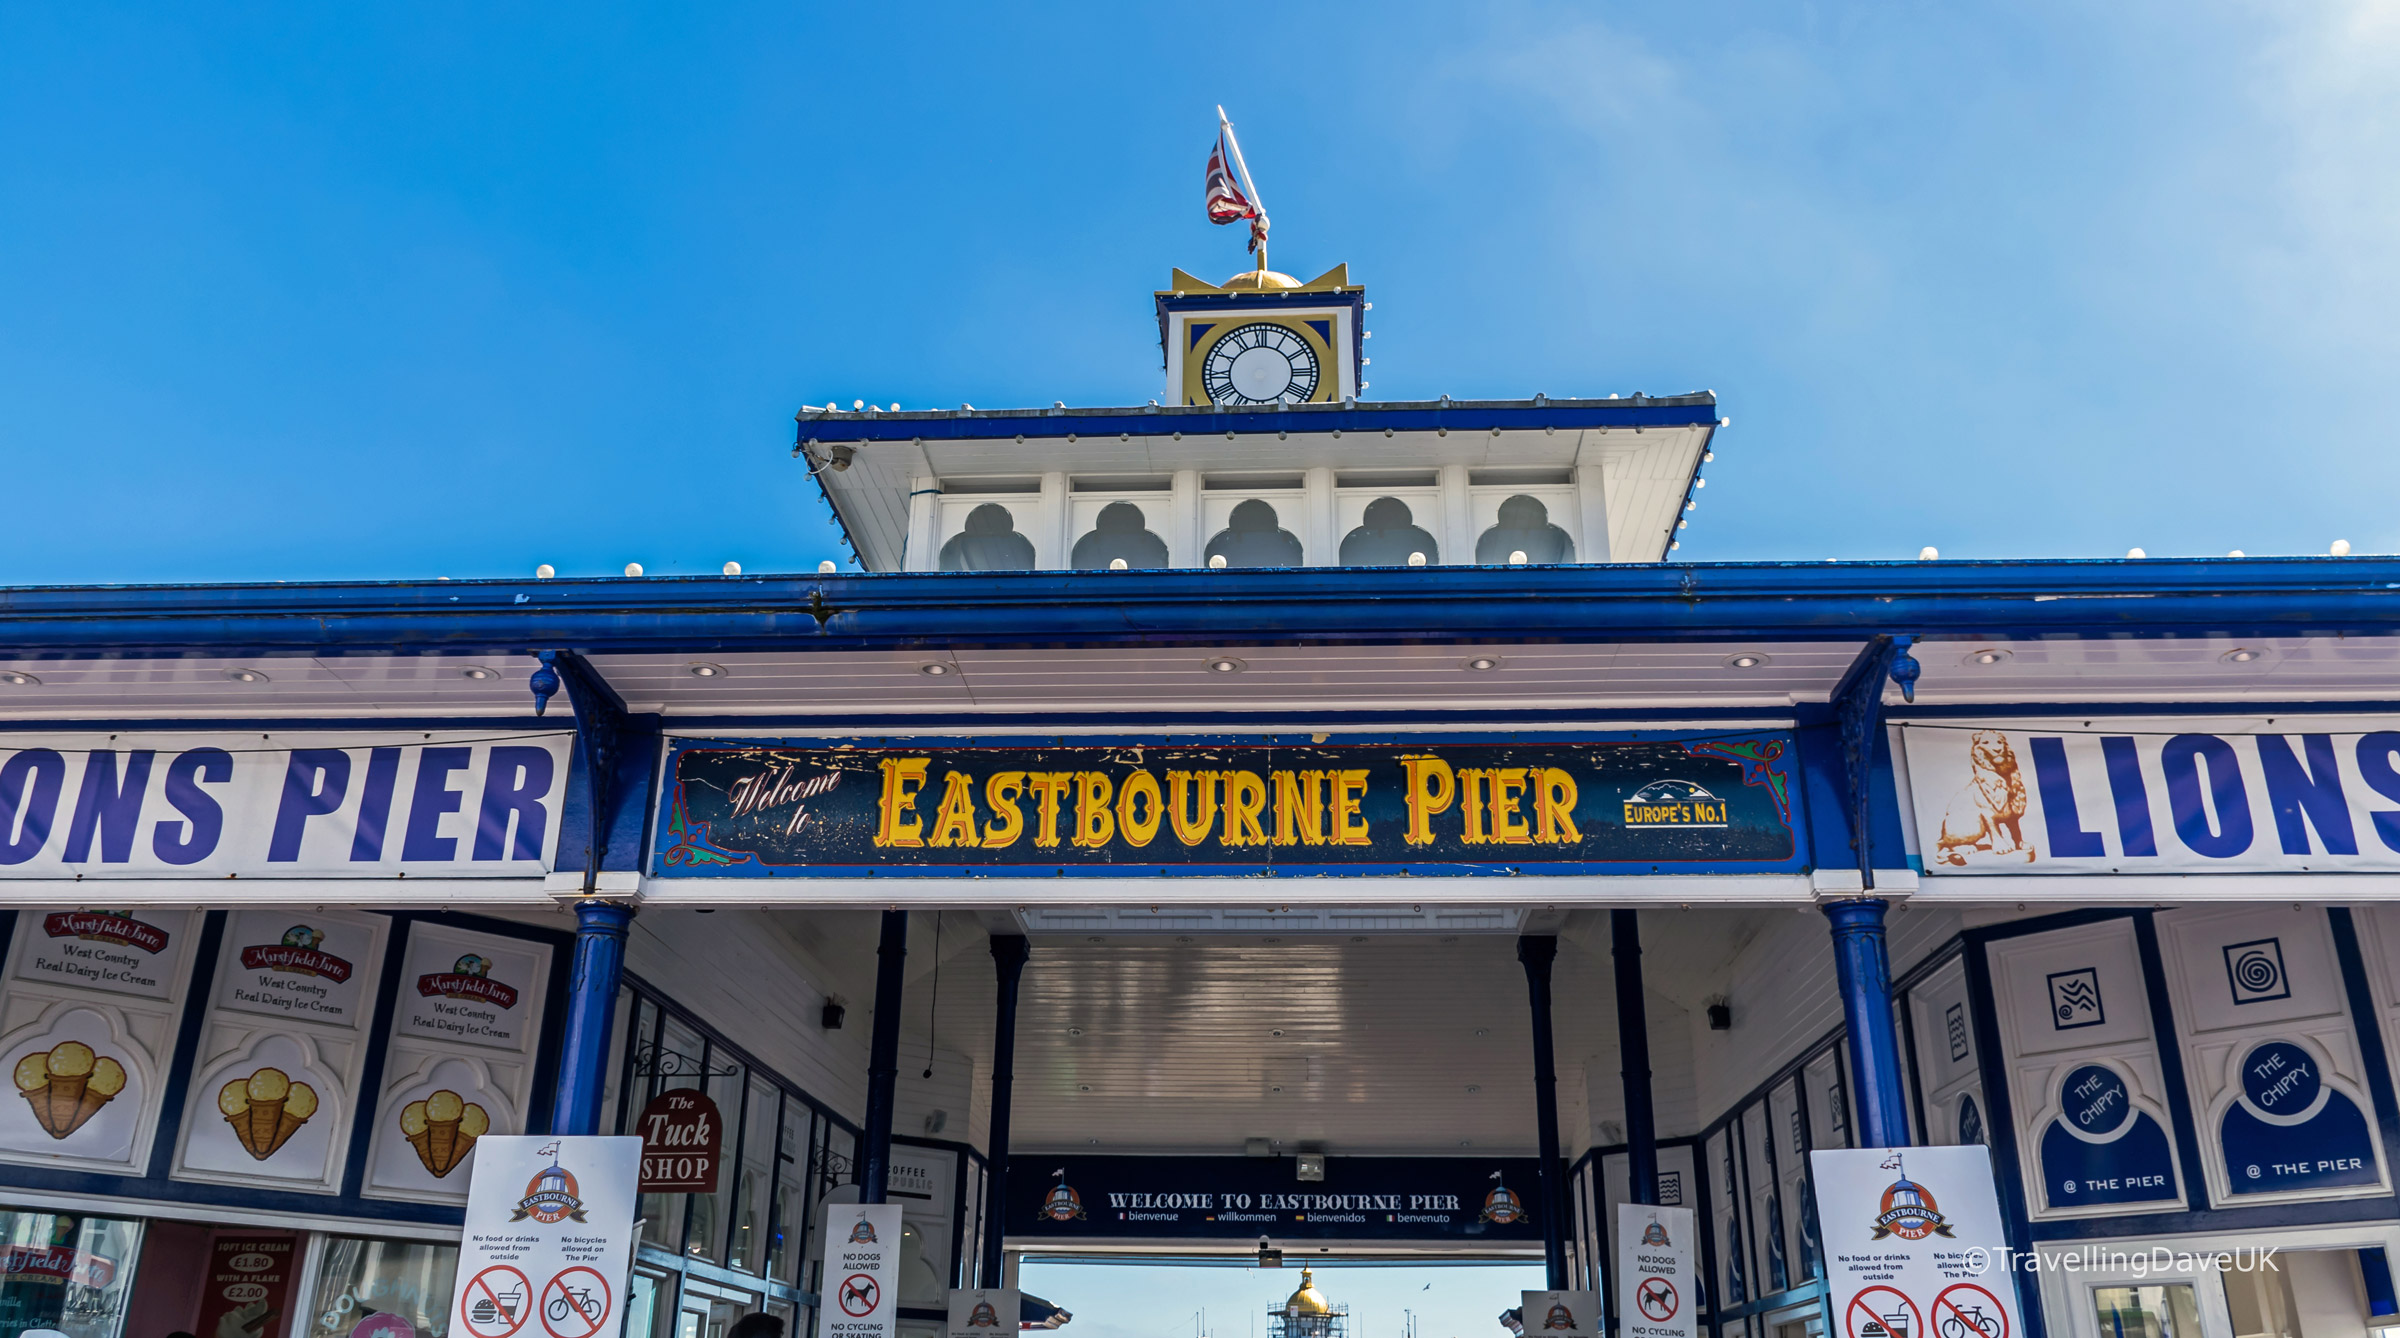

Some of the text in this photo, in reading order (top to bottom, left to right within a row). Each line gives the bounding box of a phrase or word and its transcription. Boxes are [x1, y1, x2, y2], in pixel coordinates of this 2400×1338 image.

[728, 764, 842, 819] Welcome
[873, 754, 1583, 848] EASTBOURNE PIER
[266, 746, 554, 862] PIER
[787, 804, 810, 836] to
[51, 914, 128, 935] Marshfield
[128, 923, 160, 947] Farm
[63, 944, 140, 969] West Country
[249, 947, 316, 967] Marshfield
[316, 954, 344, 978] Farm
[36, 958, 156, 986] Real Dairy Ice Cream
[259, 976, 327, 998] West Country
[425, 975, 484, 993] Marshfield
[484, 982, 510, 1004] Farm
[235, 988, 342, 1014] Real Dairy Ice Cream
[434, 1003, 495, 1023] West Country
[413, 1015, 510, 1038] Real Dairy Ice Cream
[2253, 1053, 2286, 1080] THE
[2074, 1075, 2103, 1100] THE
[2260, 1063, 2310, 1107] CHIPPY
[668, 1096, 695, 1110] The
[2079, 1084, 2124, 1126] CHIPPY
[647, 1112, 711, 1146] Tuck
[642, 1158, 709, 1180] SHOP
[2272, 1161, 2310, 1175] THE
[2318, 1158, 2362, 1172] PIER
[888, 1176, 933, 1190] PUBLIC
[2086, 1178, 2121, 1190] THE
[2126, 1175, 2165, 1188] PIER
[523, 1192, 579, 1209] EASTBOURNE
[1108, 1193, 1460, 1210] WELCOME TO EASTBOURNE PIER
[536, 1211, 560, 1222] PIER
[1129, 1211, 1450, 1222] bienvenue willkommen bienvenidos benvenuto
[1880, 1208, 1940, 1226] EASTBOURNE
[1898, 1227, 1925, 1238] PIER
[218, 1243, 291, 1252] SOFT ICE CREAM
[858, 1253, 881, 1261] DOGS
[234, 1258, 269, 1268] £1.80
[1638, 1255, 1676, 1265] NO DOGS
[1638, 1265, 1676, 1274] ALLOWED
[216, 1274, 240, 1282] WITH
[251, 1275, 280, 1283] FLAKE
[228, 1288, 263, 1297] £2.00
[1649, 1328, 1685, 1337] CYCLING
